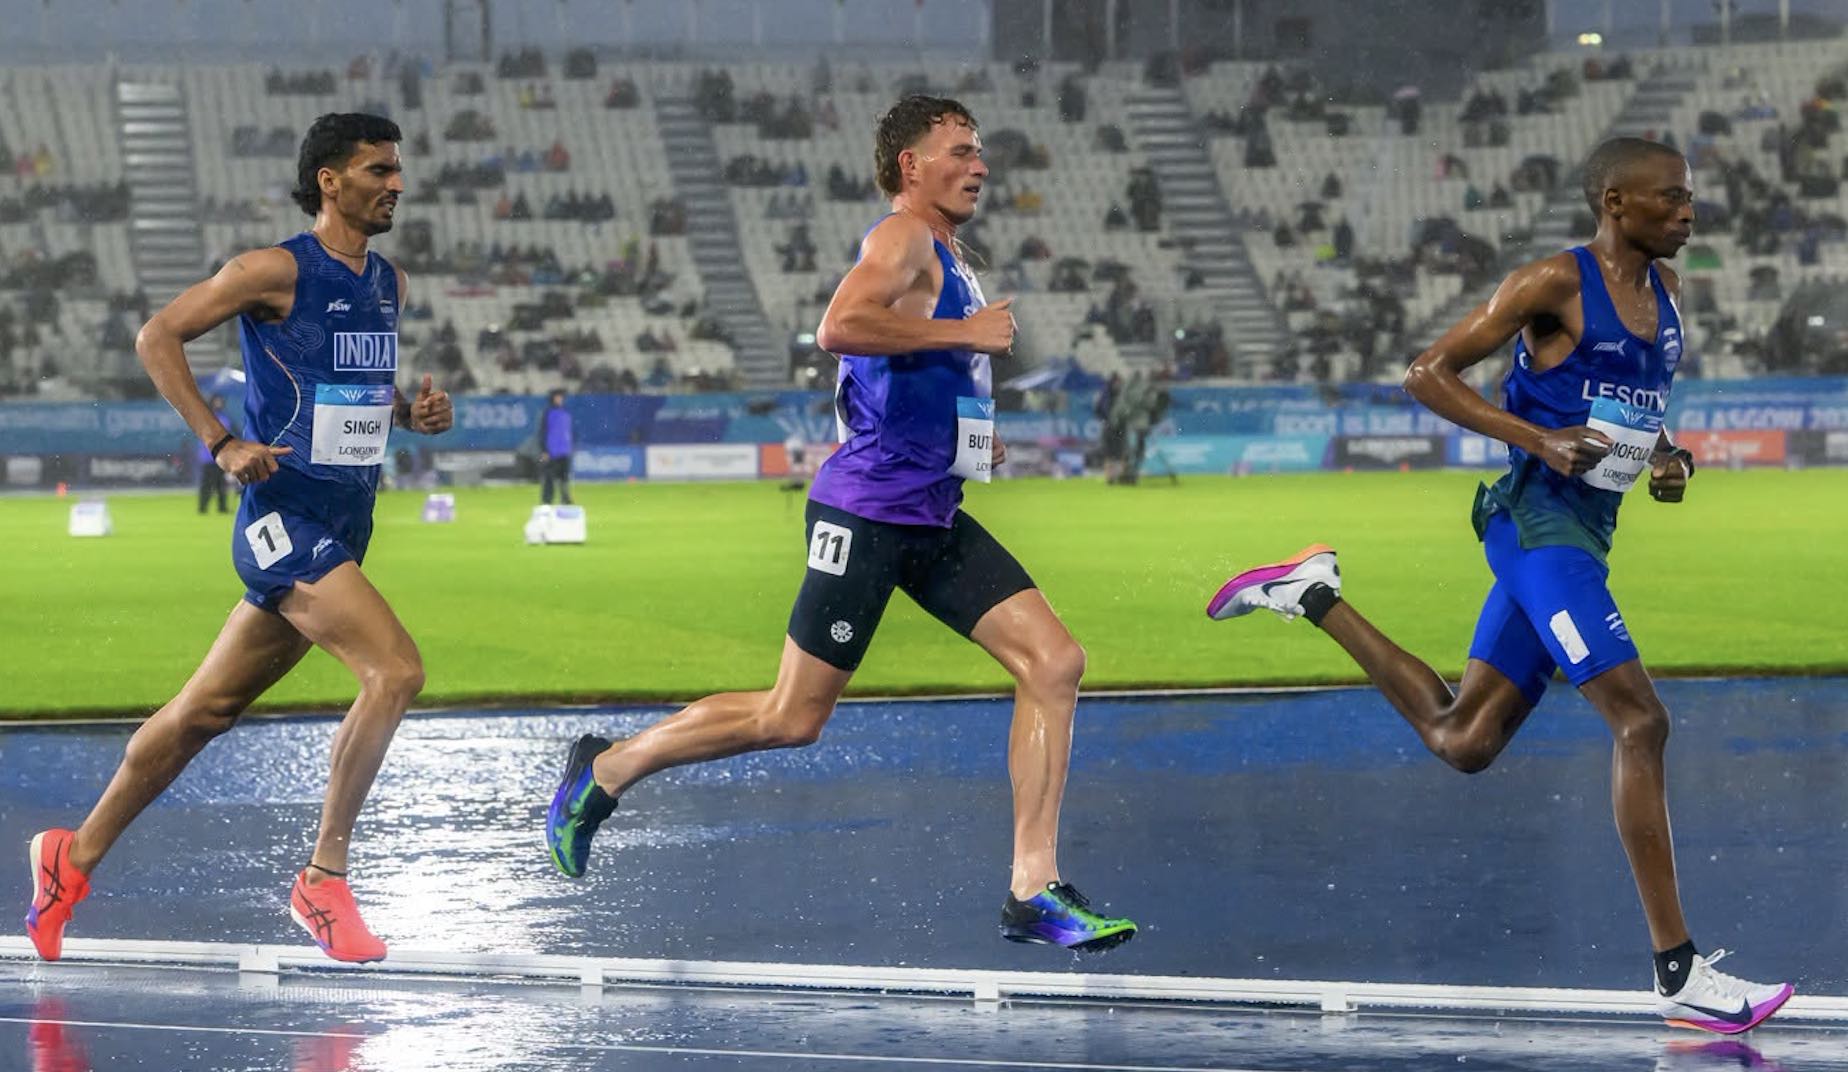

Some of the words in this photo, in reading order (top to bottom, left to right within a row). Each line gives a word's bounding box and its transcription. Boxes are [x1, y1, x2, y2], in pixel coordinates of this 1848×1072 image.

[339, 333, 391, 368] INDIA
[343, 420, 382, 435] SINGH
[463, 403, 527, 429] 2026
[257, 525, 276, 553] 1
[817, 531, 845, 564] 11
